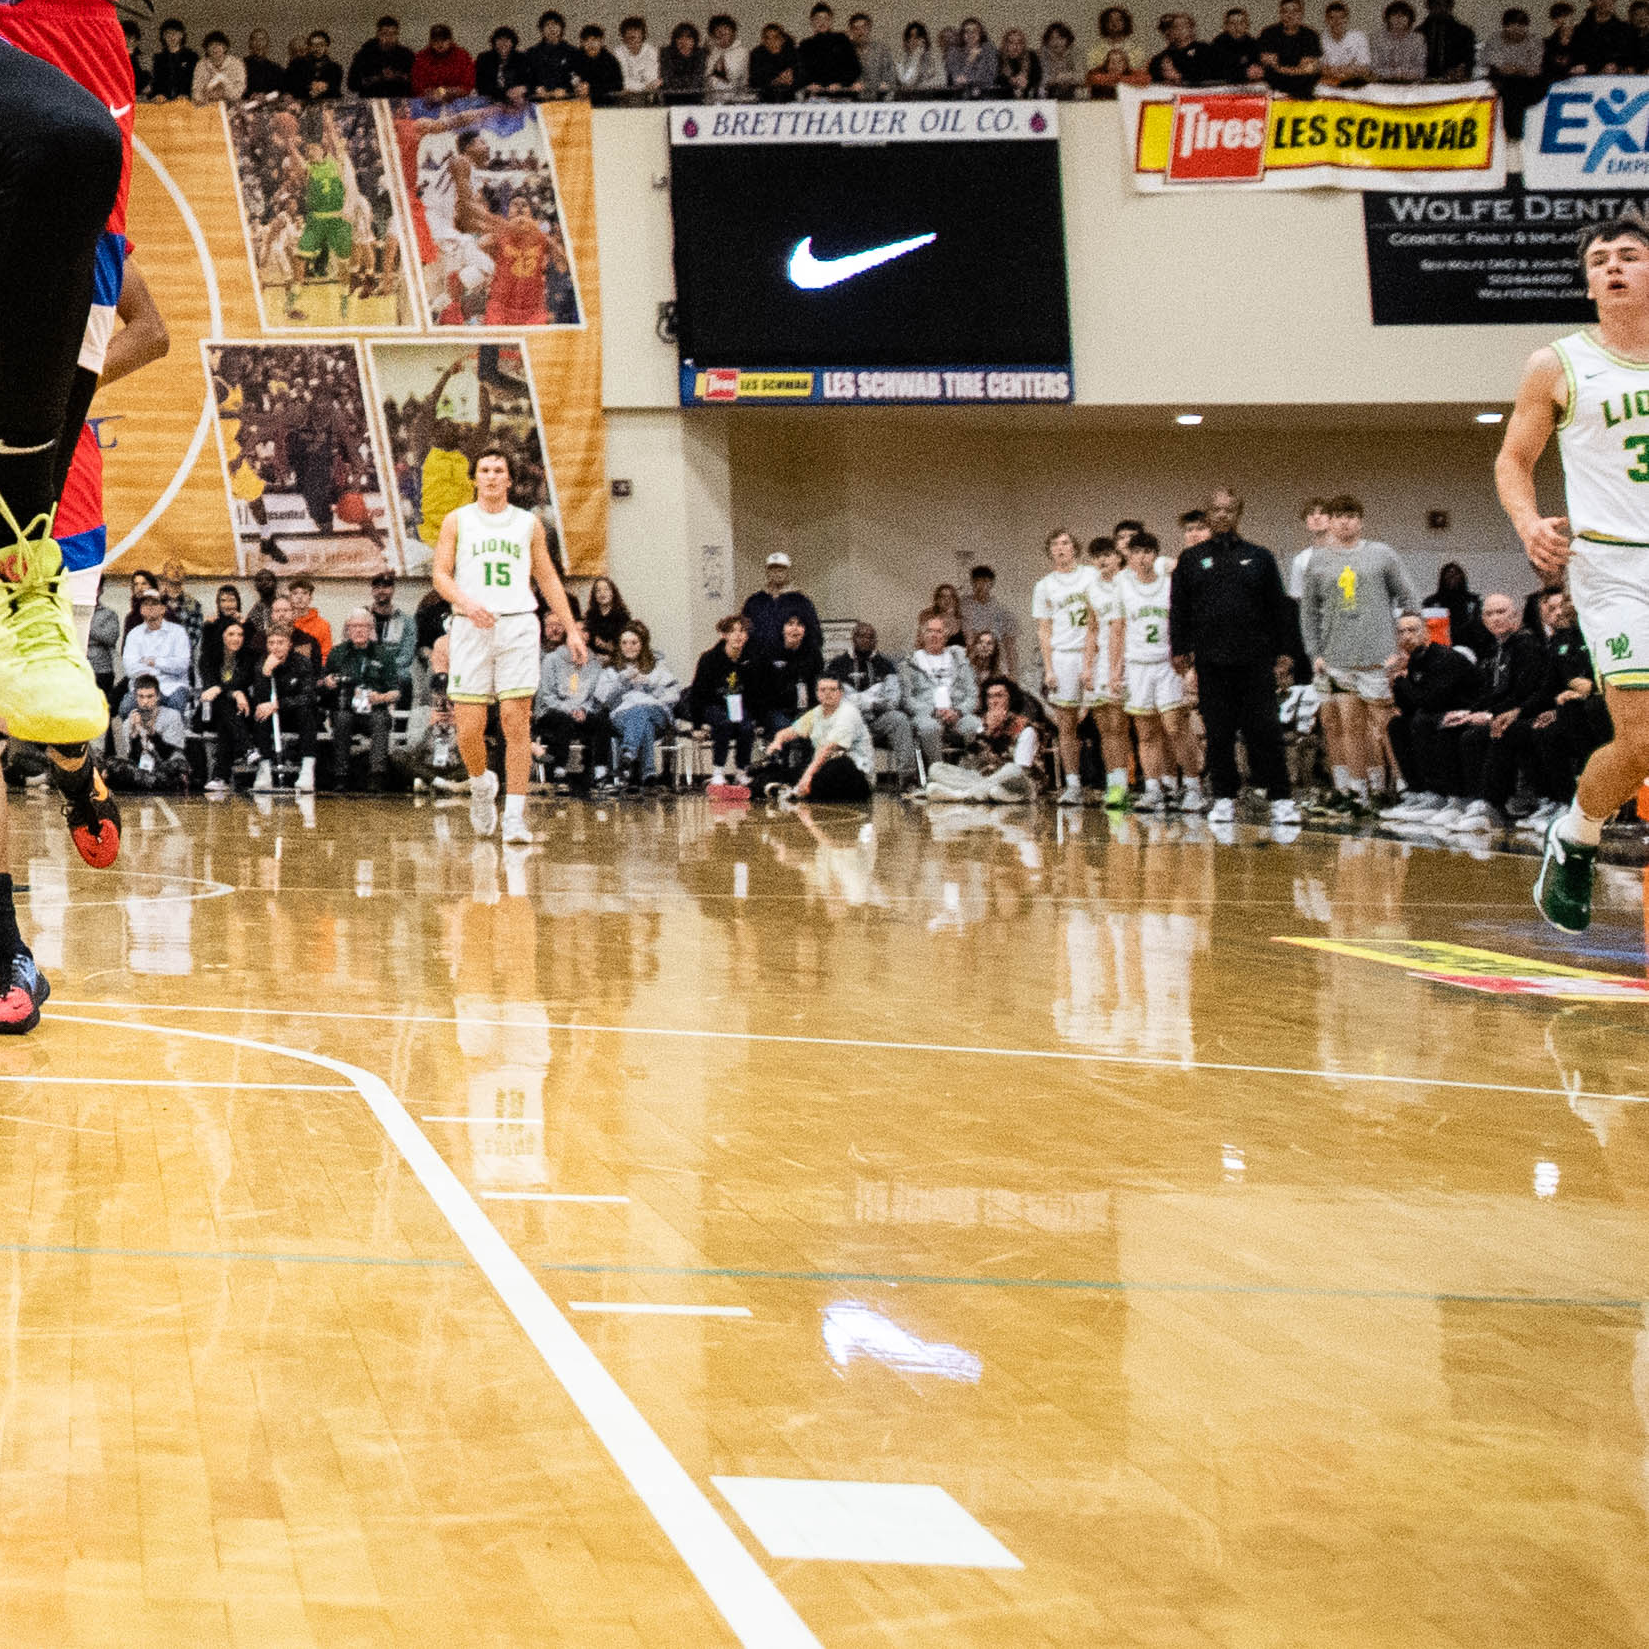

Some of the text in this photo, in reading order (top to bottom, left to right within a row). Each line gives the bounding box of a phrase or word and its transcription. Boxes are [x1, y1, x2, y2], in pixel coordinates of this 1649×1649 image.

[711, 107, 1021, 137] BRETTHAUER OIL CO.
[1178, 101, 1479, 157] Tires LES SCHWAB
[822, 371, 1070, 399] LES SCHWAB TIRE CENTERS
[1602, 390, 1649, 428] LIO
[472, 538, 522, 560] LIONS
[484, 562, 511, 586] 15
[1068, 608, 1088, 628] 12
[1145, 624, 1159, 644] 2
